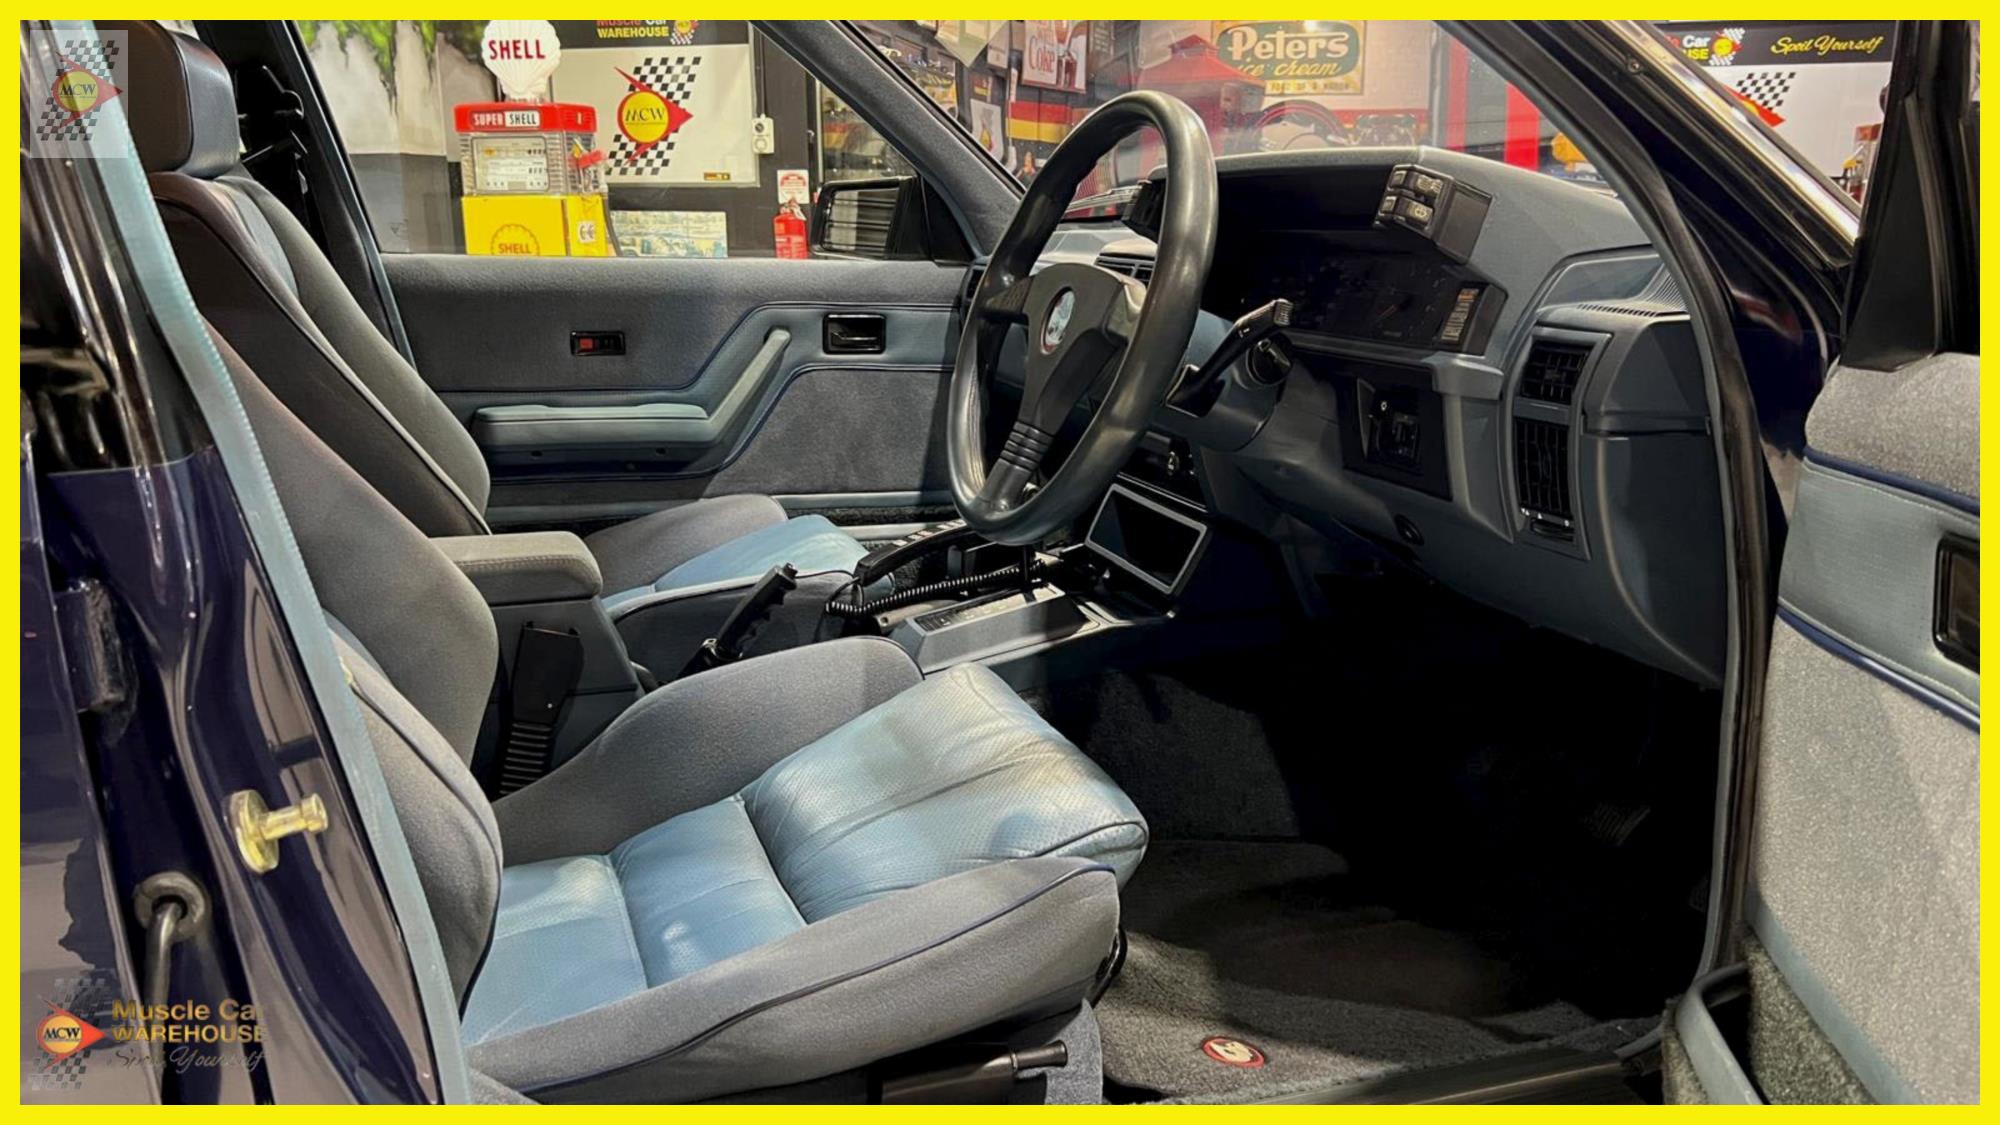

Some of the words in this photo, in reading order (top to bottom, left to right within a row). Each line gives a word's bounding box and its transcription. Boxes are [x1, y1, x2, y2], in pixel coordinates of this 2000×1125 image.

[597, 26, 669, 38] WAREHOUSE
[1227, 26, 1349, 61] Peters
[1682, 35, 1711, 48] Car
[1814, 34, 1884, 56] Yourself
[488, 39, 546, 60] SHELL
[1237, 58, 1265, 76] ice
[1273, 60, 1341, 77] cream
[473, 112, 504, 126] SUPER
[508, 113, 537, 125] SHELL
[625, 107, 665, 121] MCW
[498, 243, 531, 254] SHELL
